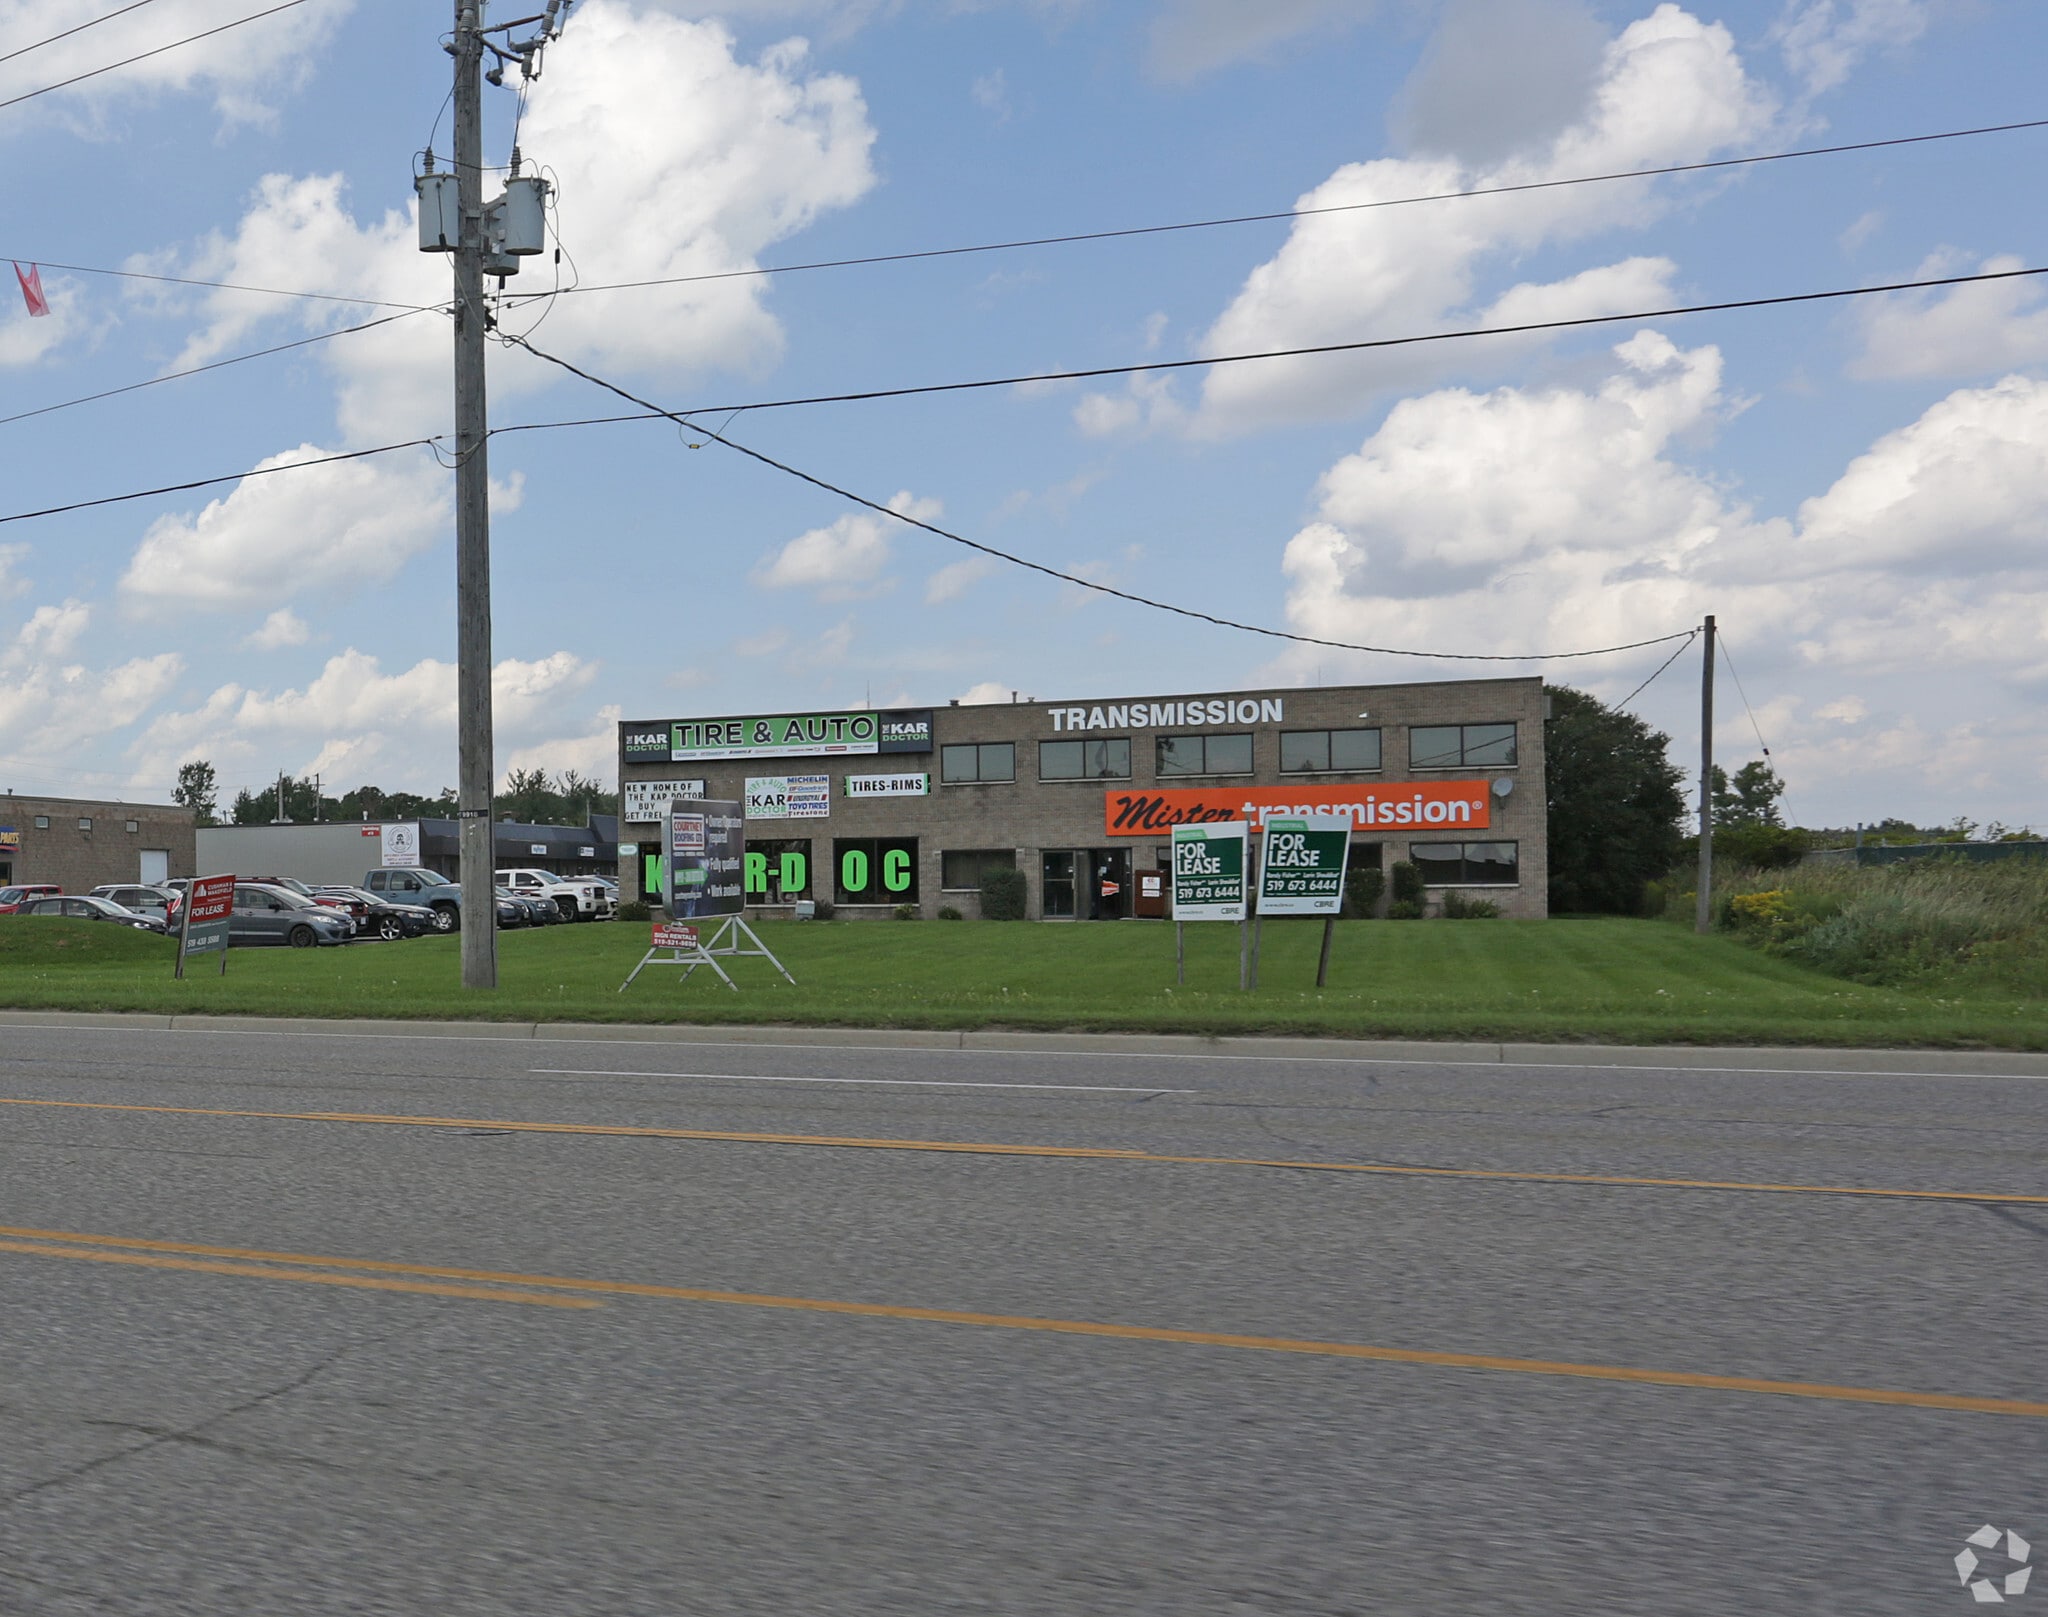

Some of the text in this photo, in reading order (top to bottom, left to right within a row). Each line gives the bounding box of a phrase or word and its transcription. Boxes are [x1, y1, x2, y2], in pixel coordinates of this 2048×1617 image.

[1048, 698, 1283, 731] TRANSMISSION
[674, 716, 875, 747] TIRE & AUTO
[891, 722, 928, 734] KAR
[634, 734, 667, 745] KAR
[882, 733, 929, 742] DOCTOR
[626, 744, 667, 752] DOCTOR
[768, 778, 787, 793] AUTO
[787, 776, 828, 784] MICHELIN
[852, 779, 922, 792] TIRES-RIMS
[626, 782, 692, 792] NEW HOME OF
[629, 793, 644, 801] THE
[752, 794, 786, 807] KAR
[638, 803, 656, 811] BUY
[746, 806, 787, 814] DOCTOR
[1113, 796, 1235, 829] Mister
[625, 811, 640, 820] GET
[1269, 833, 1305, 850] FOR
[1176, 842, 1206, 859] FOR
[1267, 849, 1320, 867] LEASE
[1177, 857, 1221, 875] LEASE
[1266, 879, 1337, 891] 519 673 6444
[1178, 886, 1239, 899] 519 673 6444
[191, 903, 225, 917] FOR LEASE
[1313, 900, 1334, 908] CBRE
